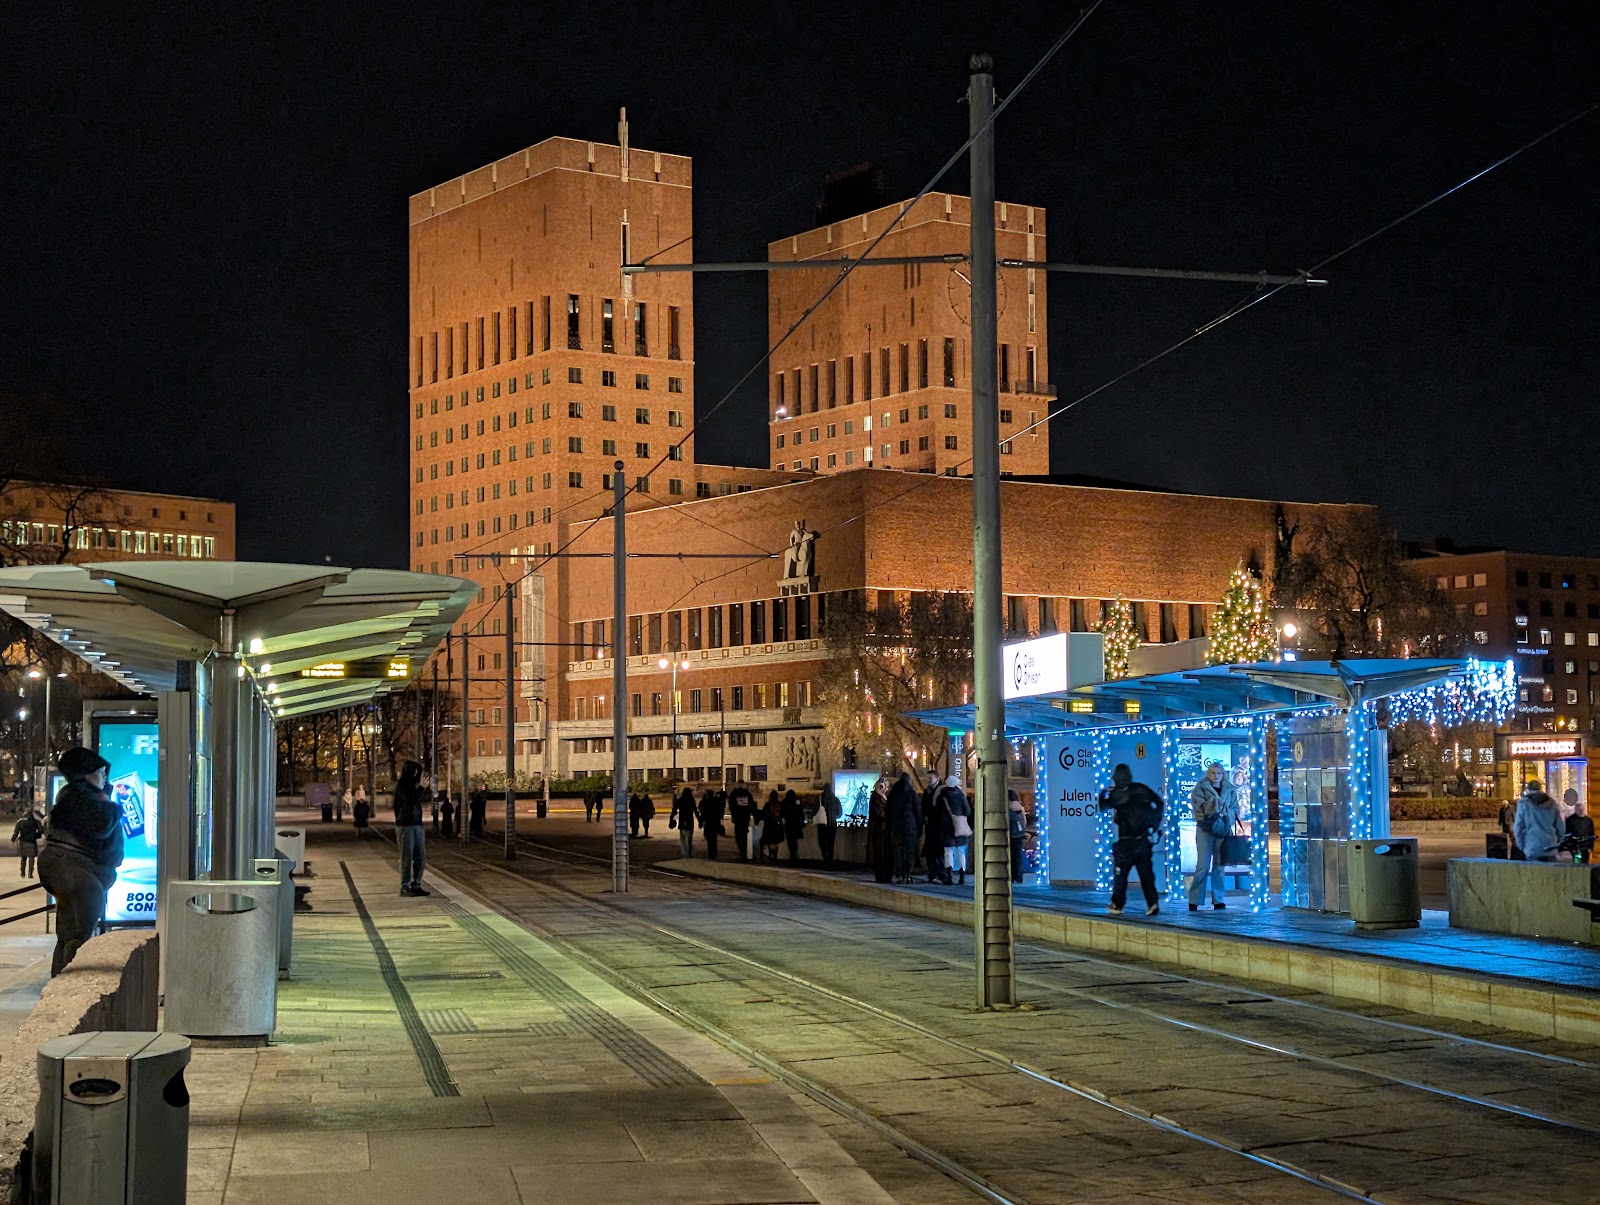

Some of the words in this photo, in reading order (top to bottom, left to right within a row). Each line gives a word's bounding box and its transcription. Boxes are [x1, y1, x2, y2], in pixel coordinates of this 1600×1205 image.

[1077, 749, 1092, 758] Cla
[1060, 788, 1092, 801] Julen
[1060, 805, 1082, 817] hos
[1085, 804, 1098, 817] Cl
[126, 903, 156, 912] CON
